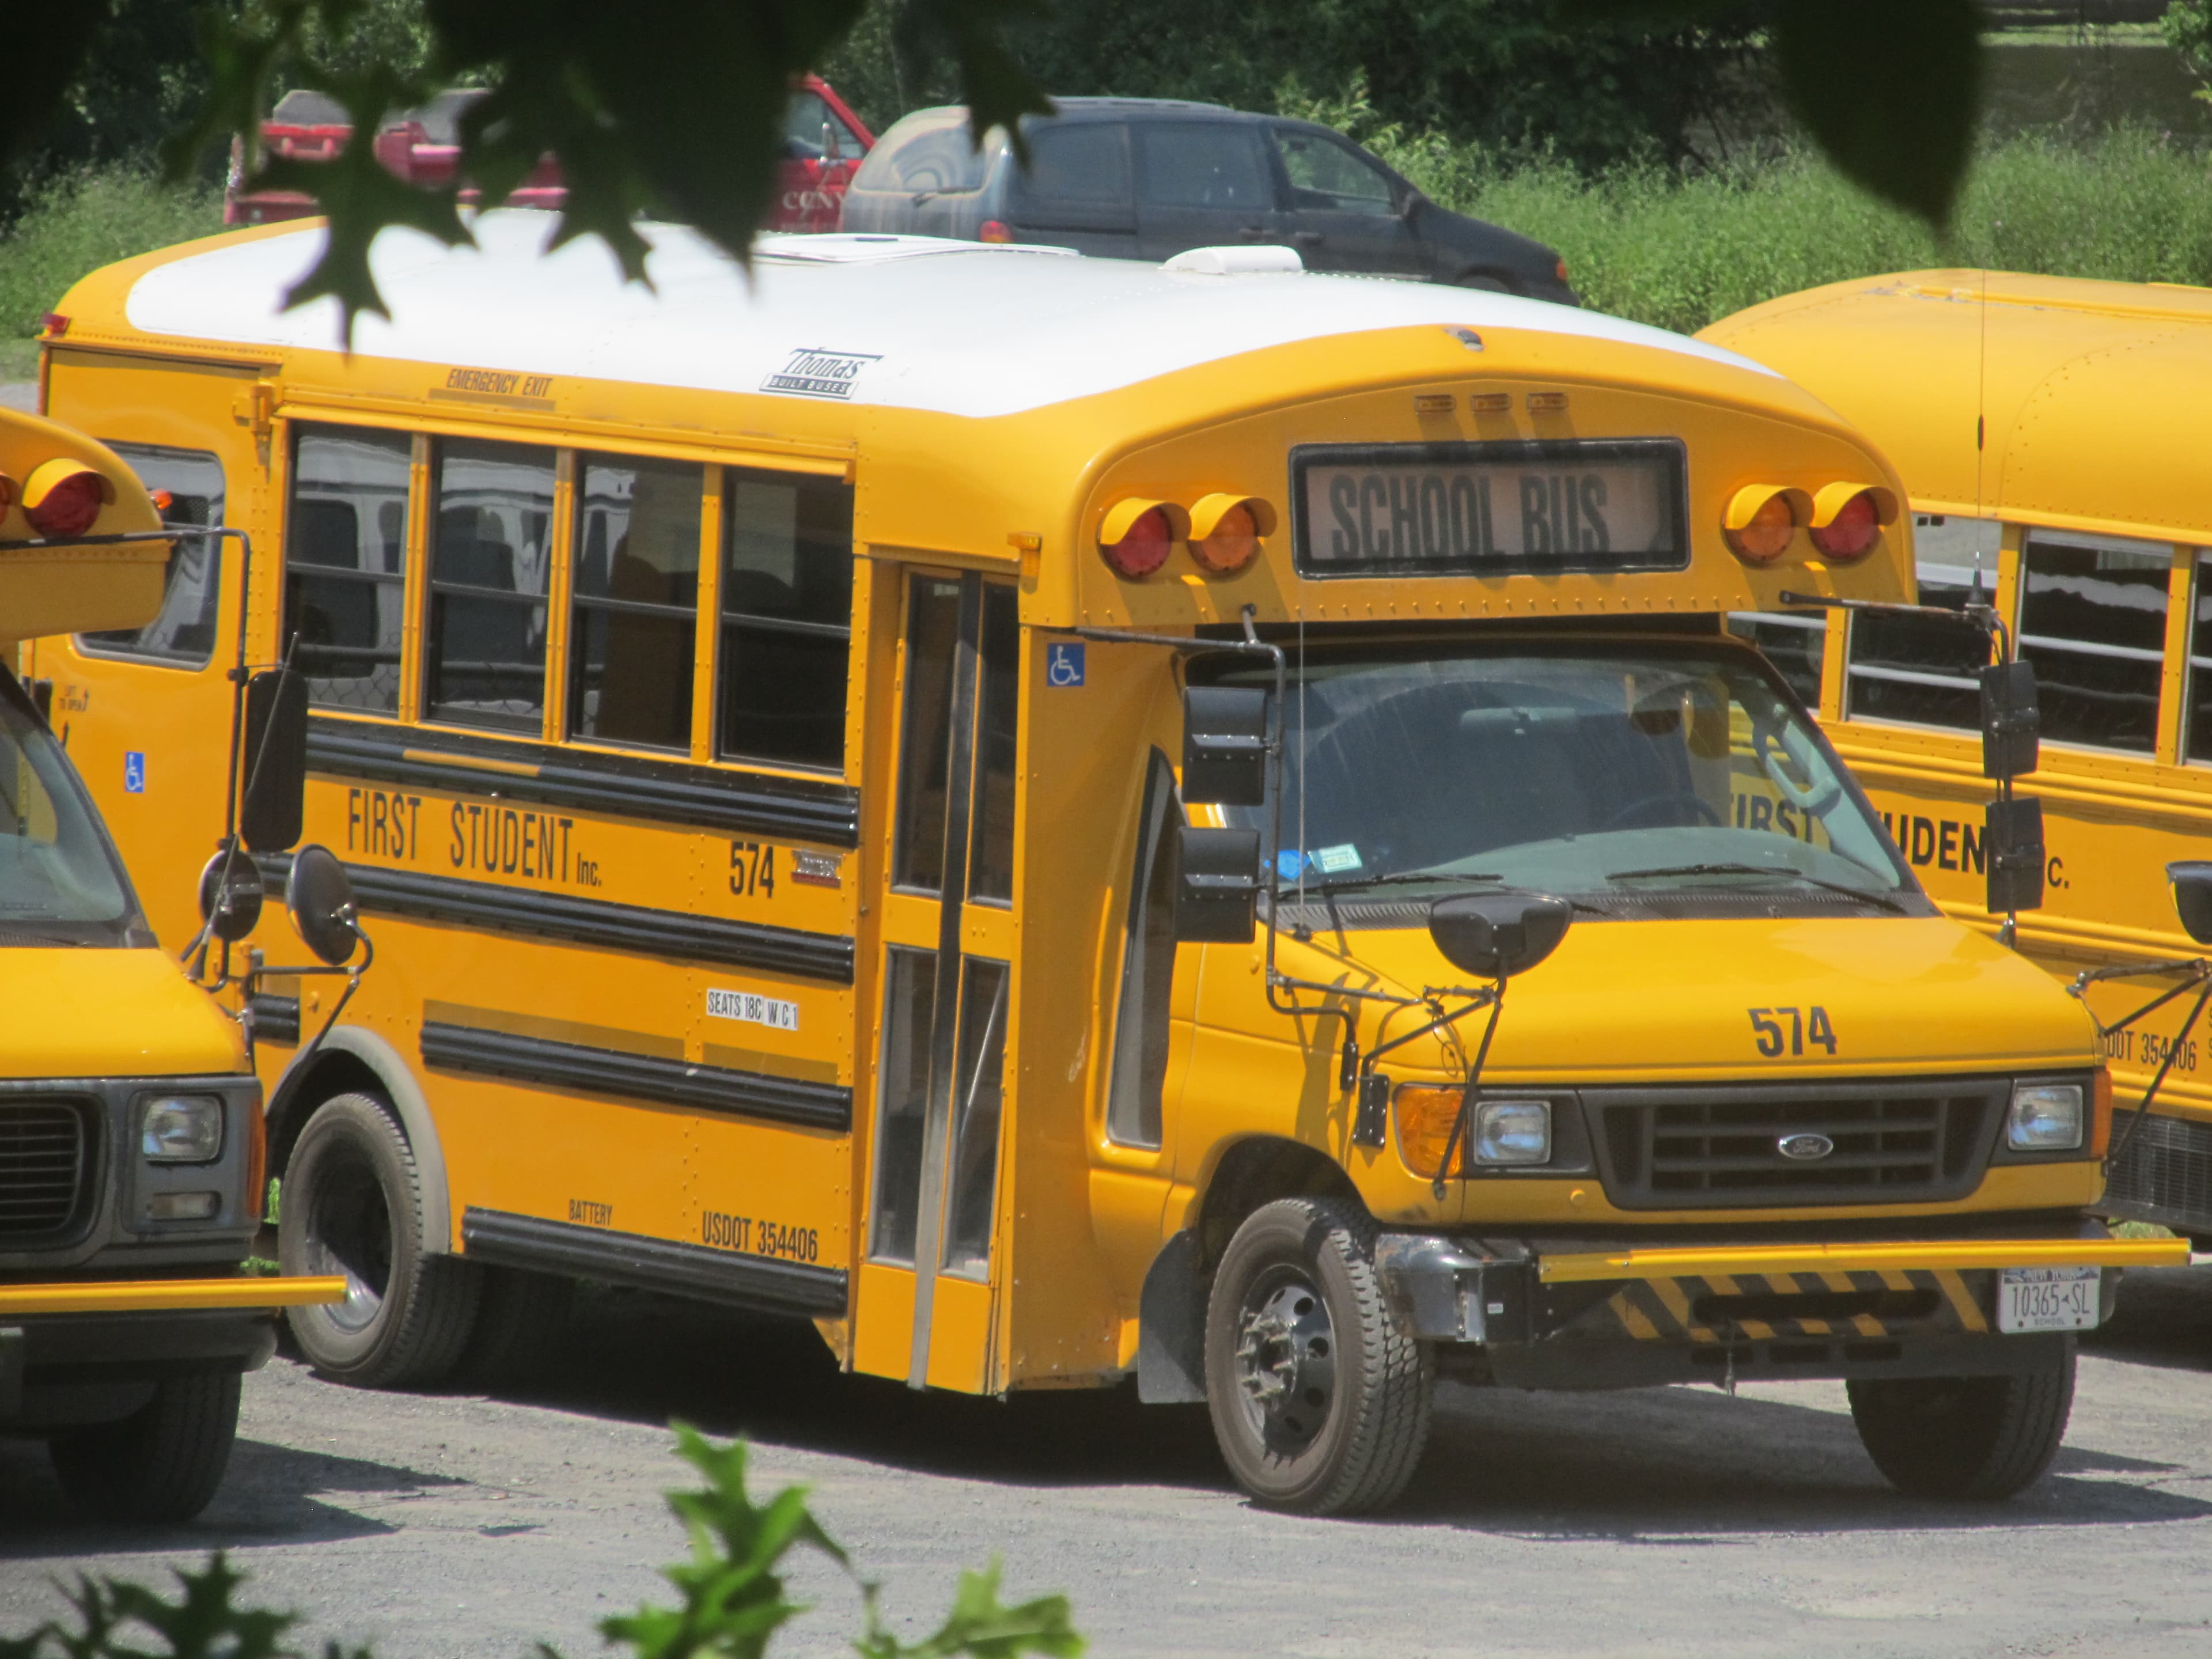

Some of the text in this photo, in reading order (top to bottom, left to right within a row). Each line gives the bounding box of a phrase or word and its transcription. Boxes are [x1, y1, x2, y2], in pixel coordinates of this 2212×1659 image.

[446, 368, 553, 397] EMERGENCY EXIT
[770, 377, 849, 393] BUILT BUSES
[781, 347, 885, 380] Thomas
[1329, 474, 1611, 559] SCHOOL BUS
[349, 788, 602, 887] FIRST STUDENT Inc.
[1729, 793, 1813, 844] IRST
[1878, 811, 1987, 875] UDEN
[729, 841, 774, 899] 574
[708, 991, 741, 1017] SEATS
[744, 997, 762, 1020] 18C
[1747, 1006, 1838, 1058] 574
[569, 1198, 613, 1226] BATTERY
[702, 1211, 818, 1262] USDOT 354406
